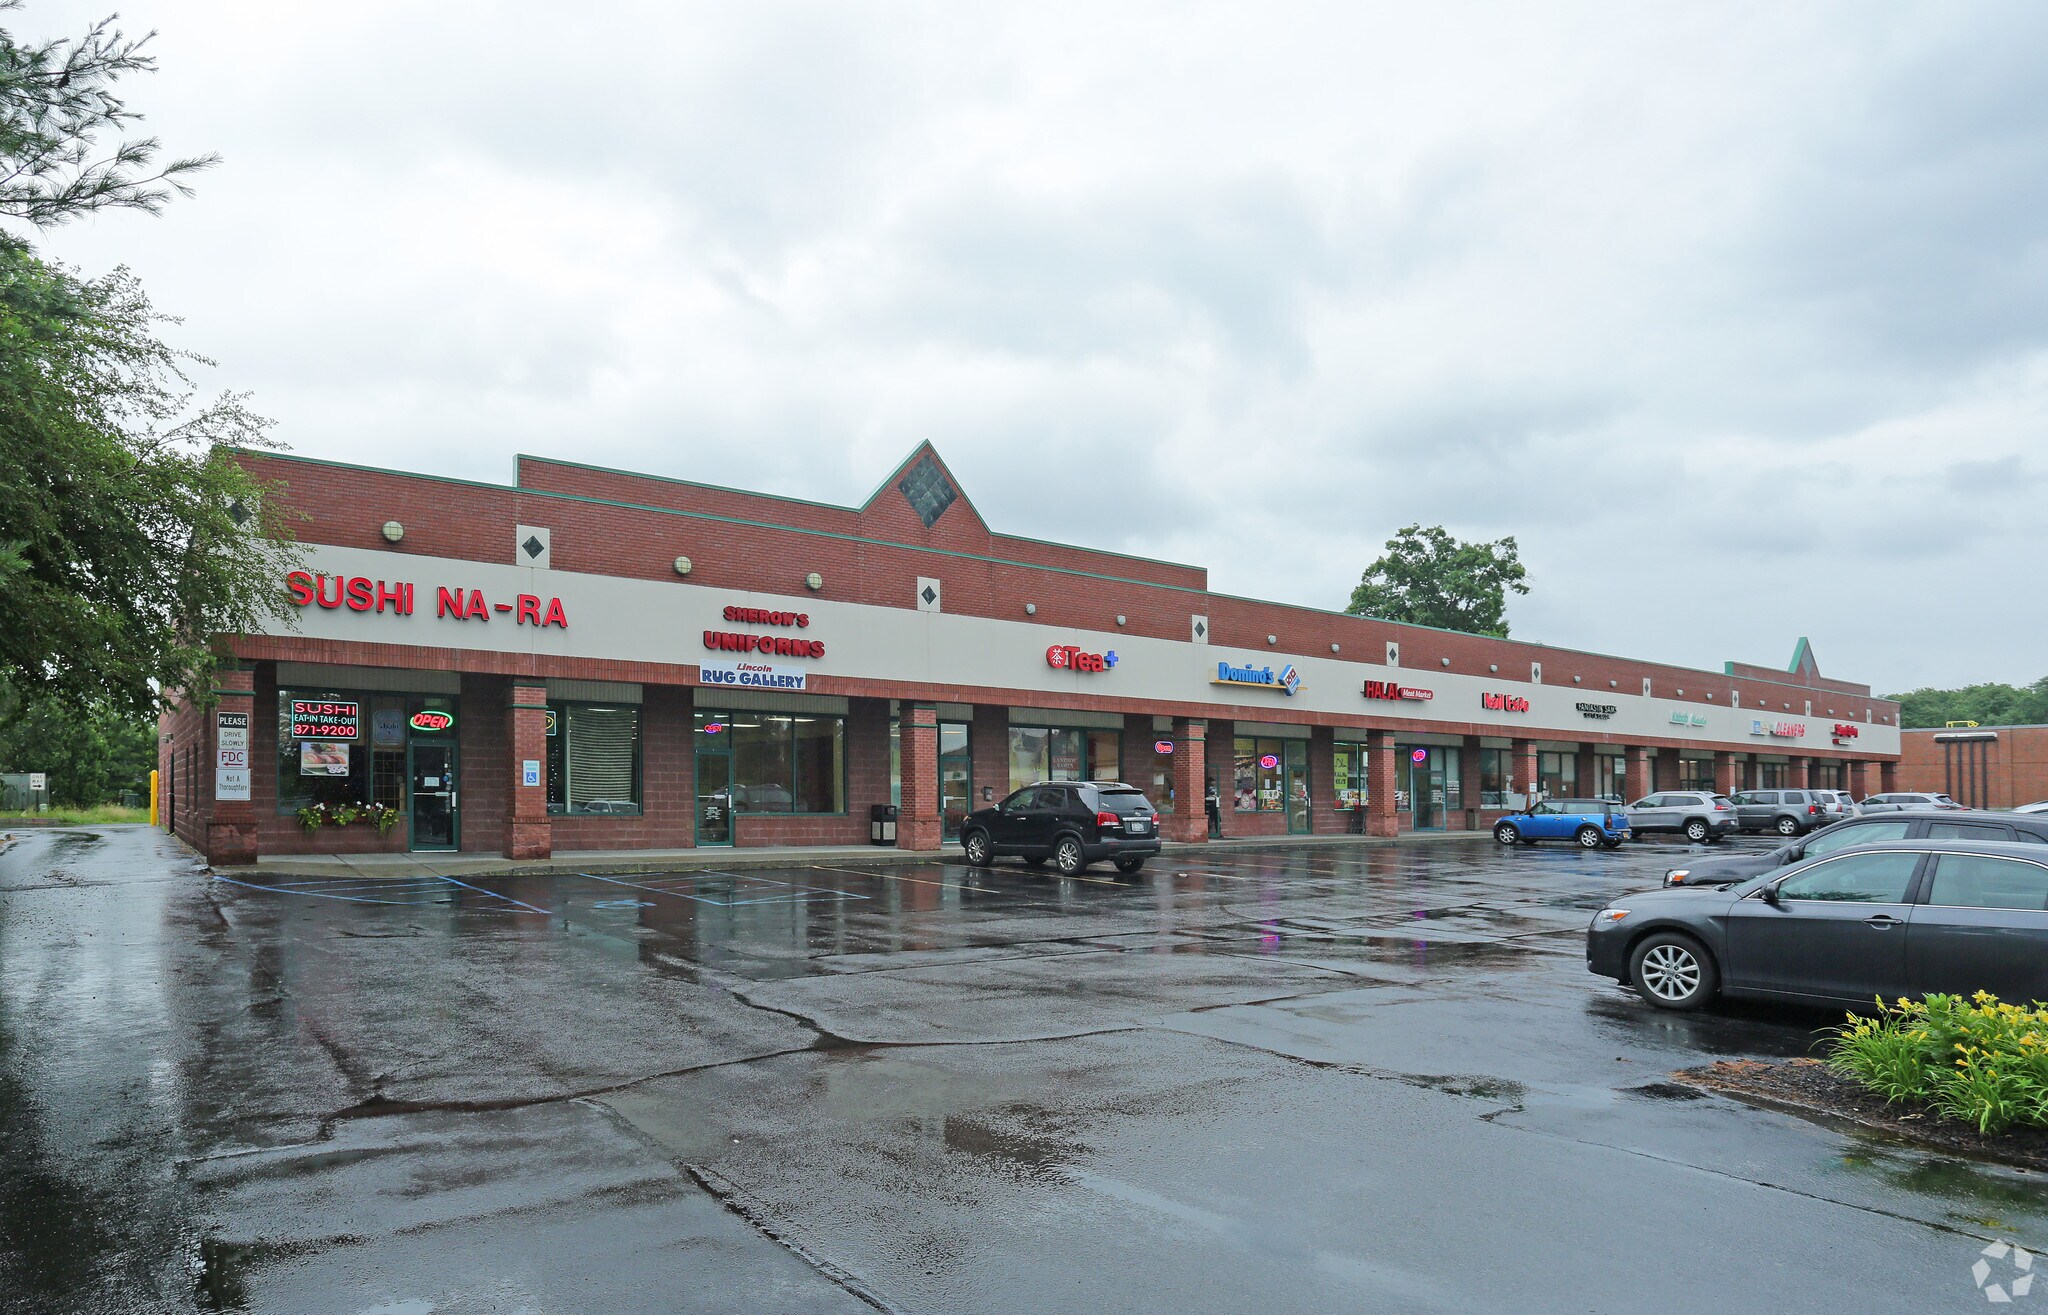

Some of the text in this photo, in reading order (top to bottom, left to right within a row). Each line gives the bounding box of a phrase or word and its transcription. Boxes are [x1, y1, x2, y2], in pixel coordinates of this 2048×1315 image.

[286, 571, 568, 628] SUSHI NA-RA
[723, 605, 810, 628] SHERON'S
[703, 630, 826, 659] UNIFORMS
[736, 662, 773, 673] Lincoln
[1218, 661, 1275, 684] Domino's
[701, 669, 804, 689] RUG GALLERY
[1364, 680, 1402, 700] HALAL
[294, 702, 356, 716] SUSHI
[1482, 692, 1503, 710] Nail
[219, 716, 247, 726] PLEASE
[294, 713, 356, 726] EAT-IN TAKE-OUT
[413, 713, 449, 729] OPEN
[293, 724, 355, 736] 371-9200
[1775, 721, 1806, 738] CLEANERS
[221, 739, 244, 747] SLOWLY
[221, 751, 243, 763] FDC
